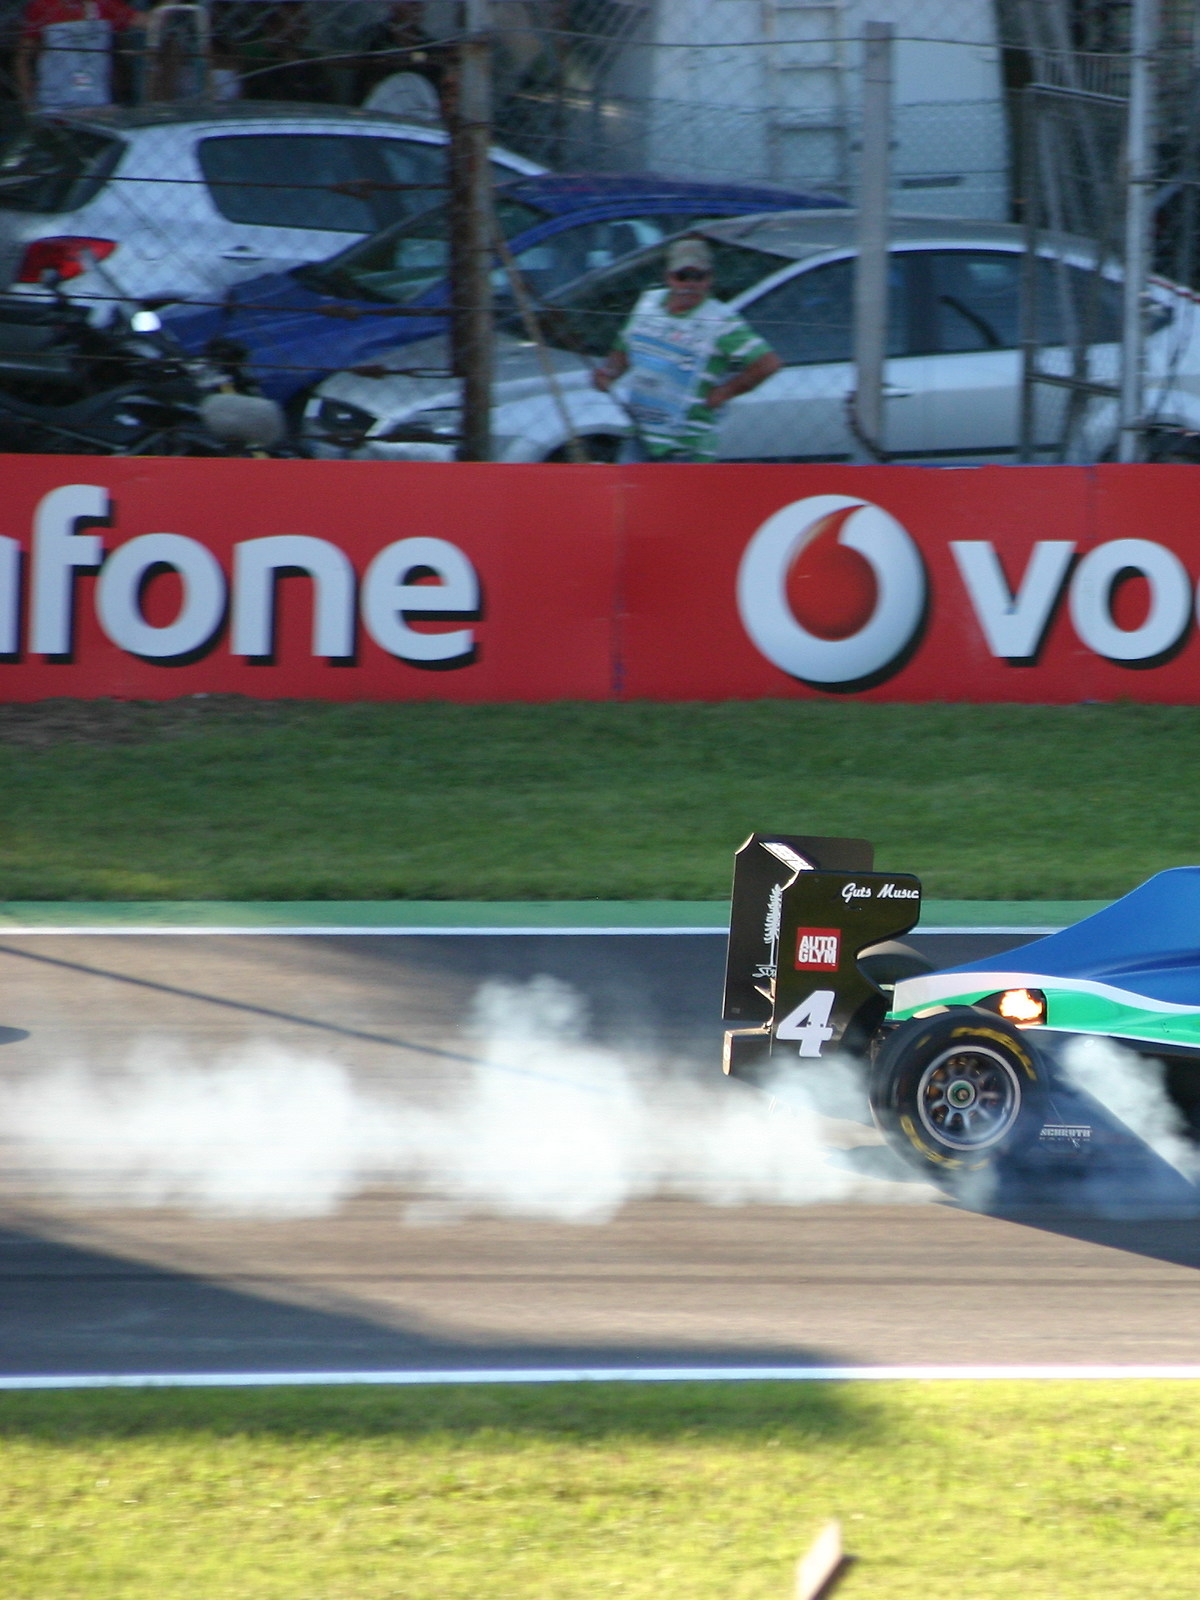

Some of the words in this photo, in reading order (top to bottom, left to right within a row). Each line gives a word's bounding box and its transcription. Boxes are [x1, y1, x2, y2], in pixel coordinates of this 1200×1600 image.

[842, 883, 872, 903] Guts
[877, 883, 919, 899] Music
[800, 936, 838, 951] AUTO
[799, 949, 836, 964] GLYM
[776, 990, 835, 1057] 4
